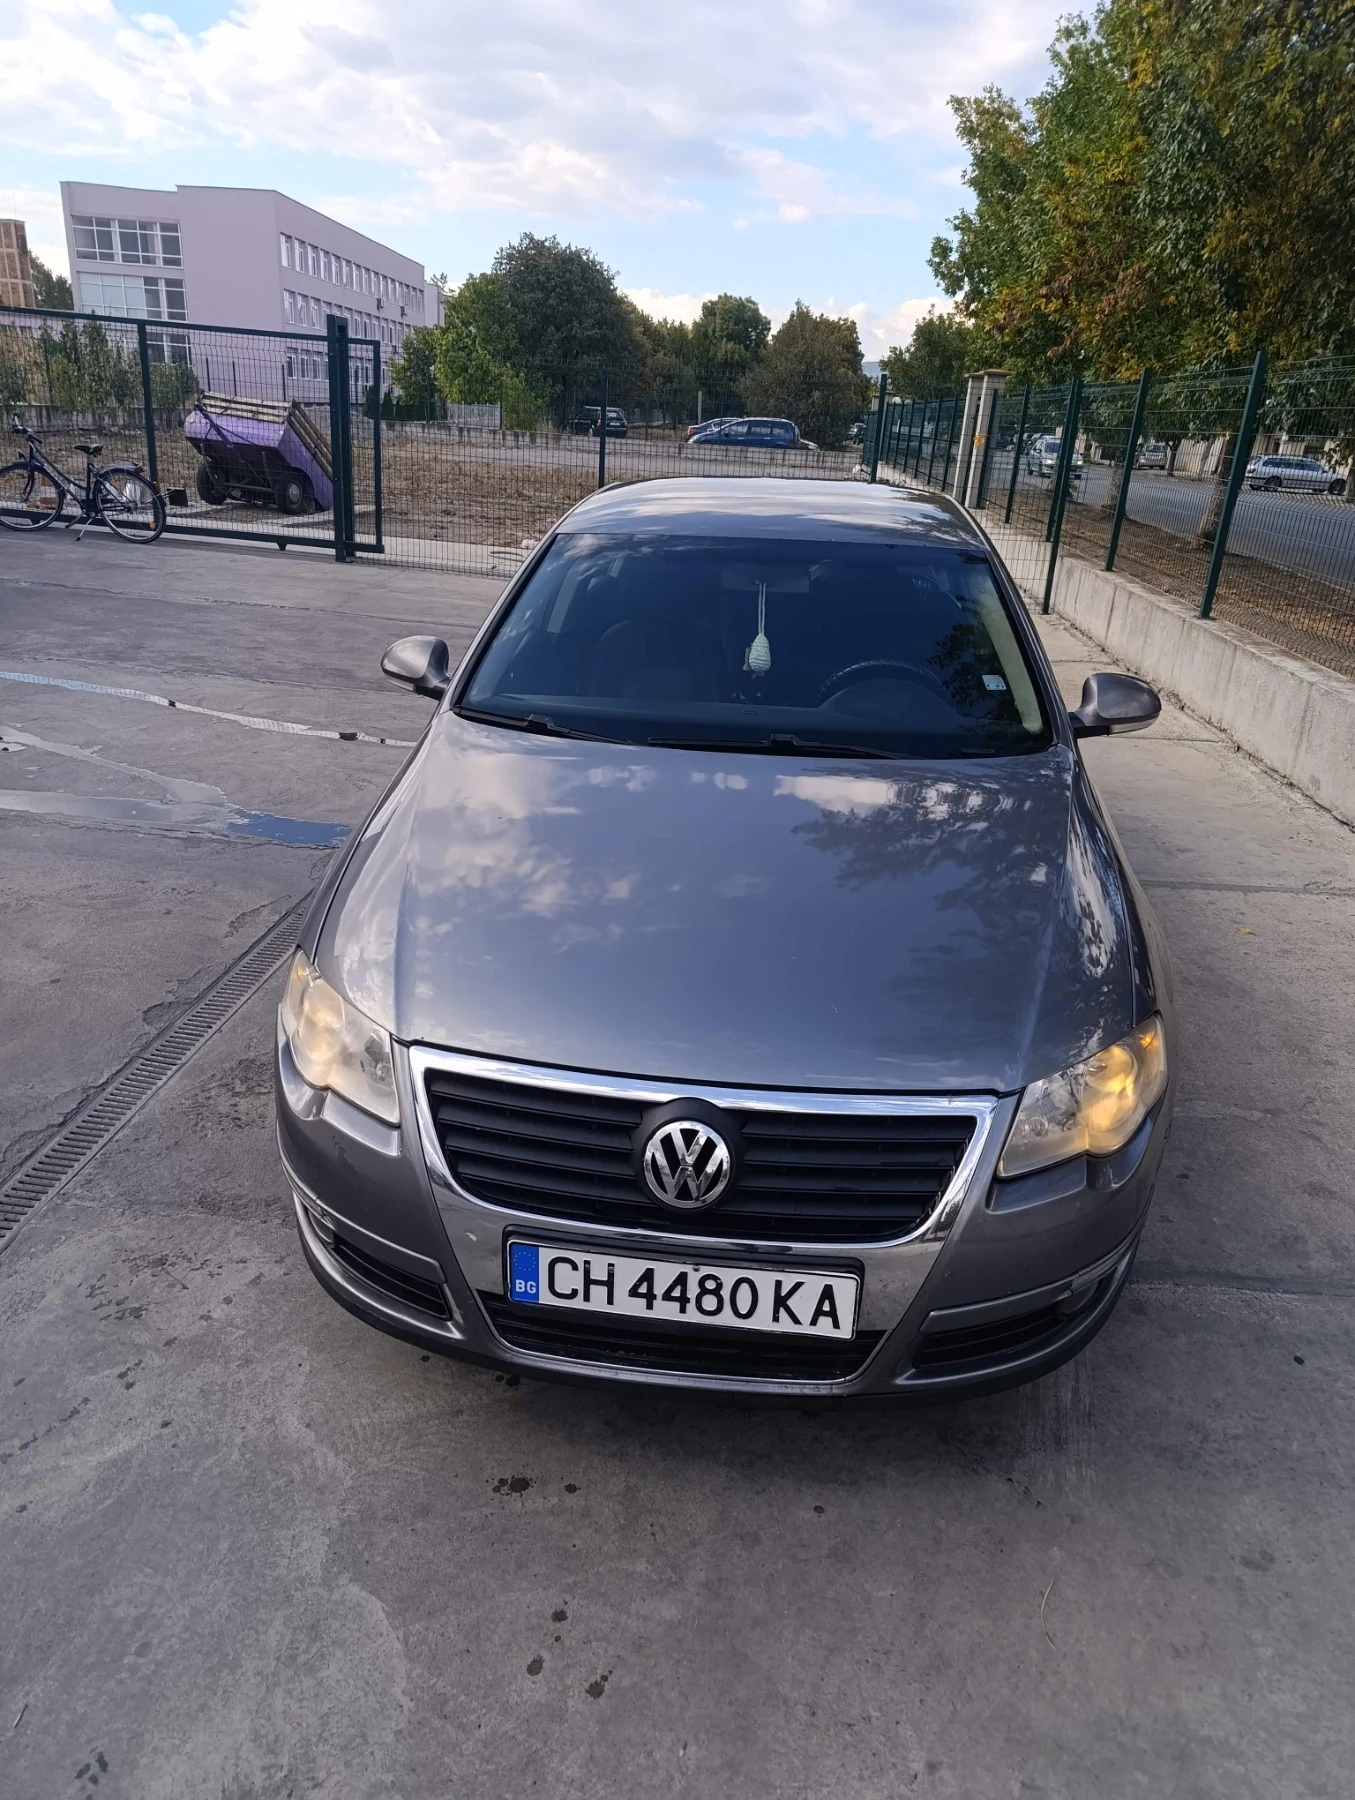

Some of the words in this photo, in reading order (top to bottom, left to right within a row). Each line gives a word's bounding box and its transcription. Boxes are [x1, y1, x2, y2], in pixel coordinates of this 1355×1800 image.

[644, 1120, 730, 1208] VW
[515, 1279, 537, 1294] BG
[547, 1256, 615, 1305] CH
[628, 1267, 759, 1320] 4480
[771, 1279, 841, 1330] KA
